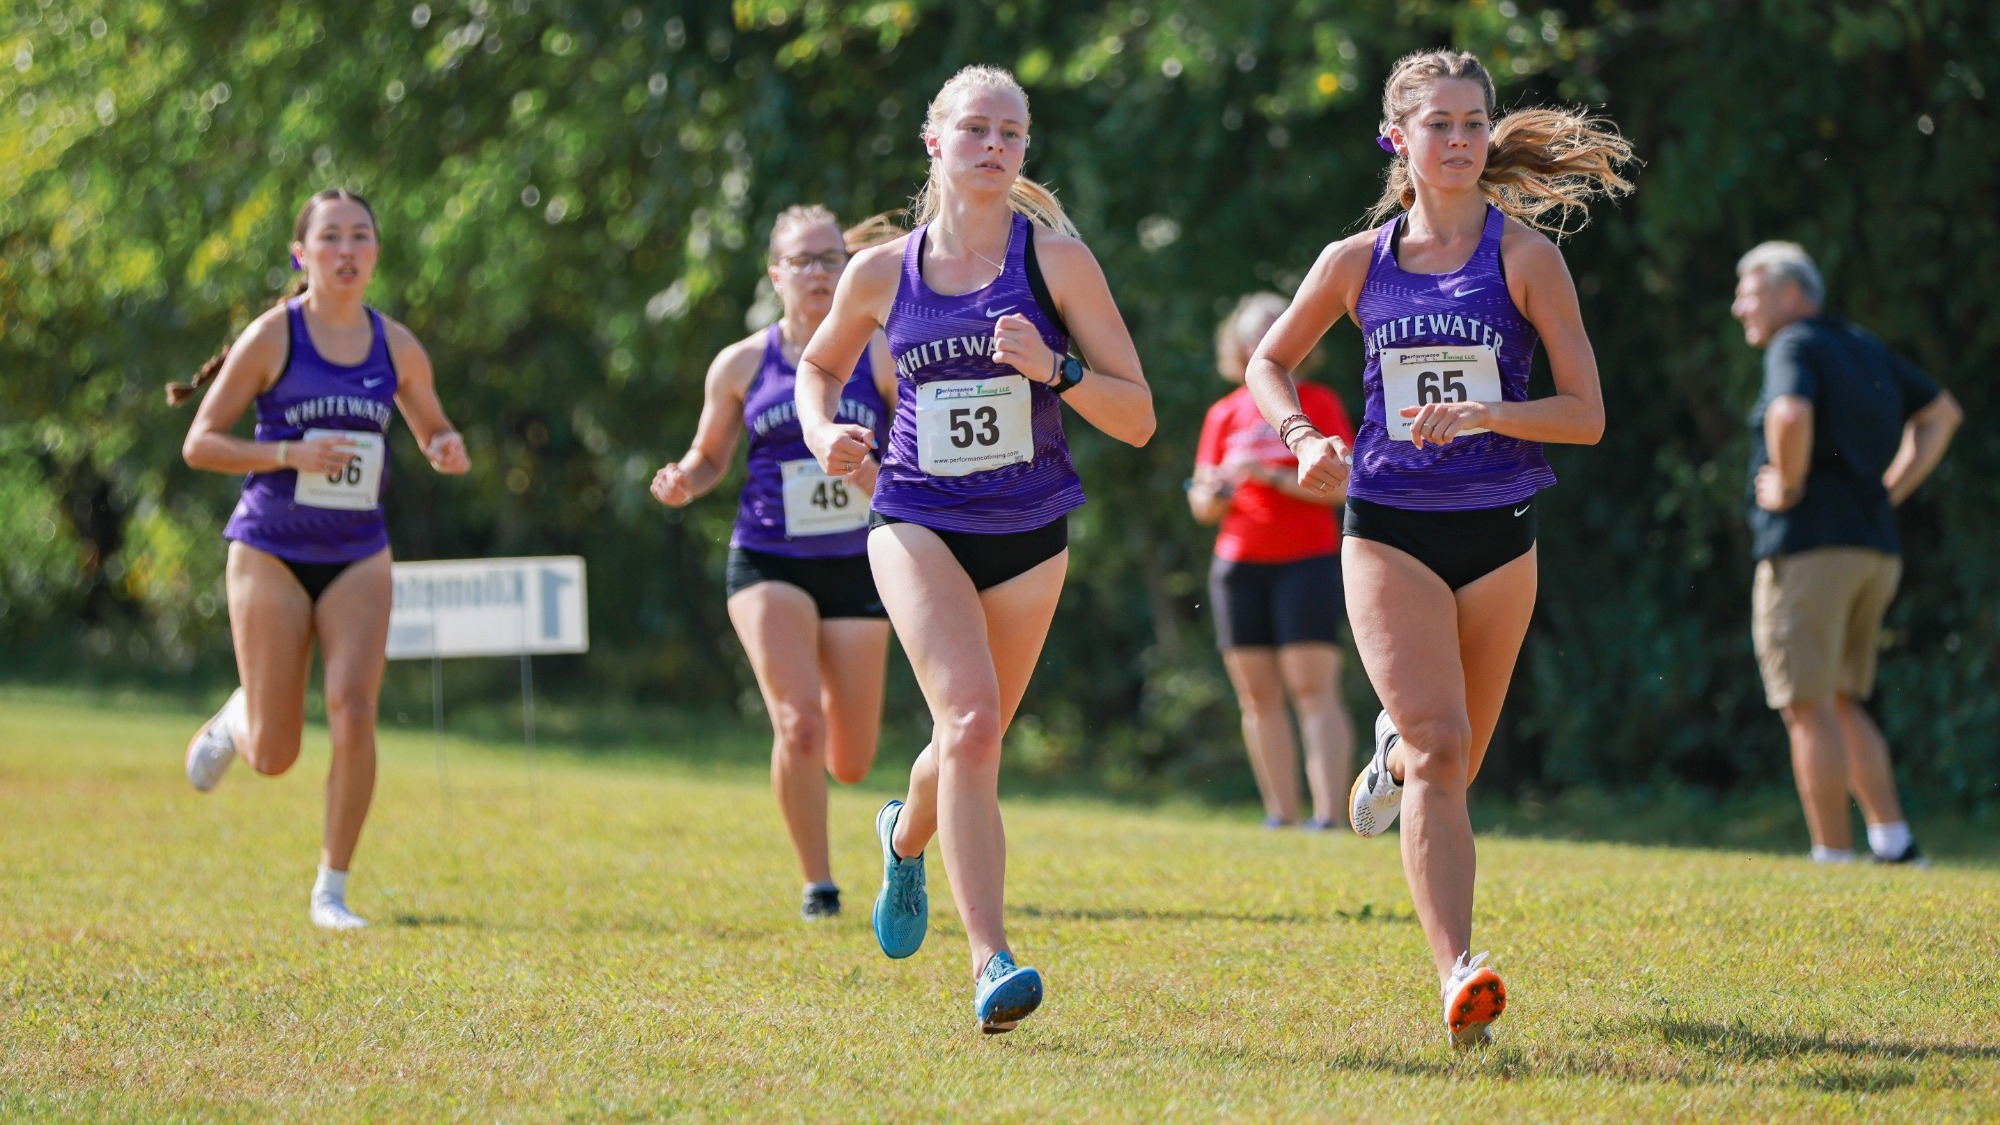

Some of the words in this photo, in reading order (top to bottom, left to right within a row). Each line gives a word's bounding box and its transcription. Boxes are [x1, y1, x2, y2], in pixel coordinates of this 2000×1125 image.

[897, 336, 998, 378] WHITEWA
[1368, 314, 1503, 358] WHITEWATER
[1417, 370, 1468, 407] 65
[950, 406, 1000, 449] 53
[811, 479, 849, 510] 48
